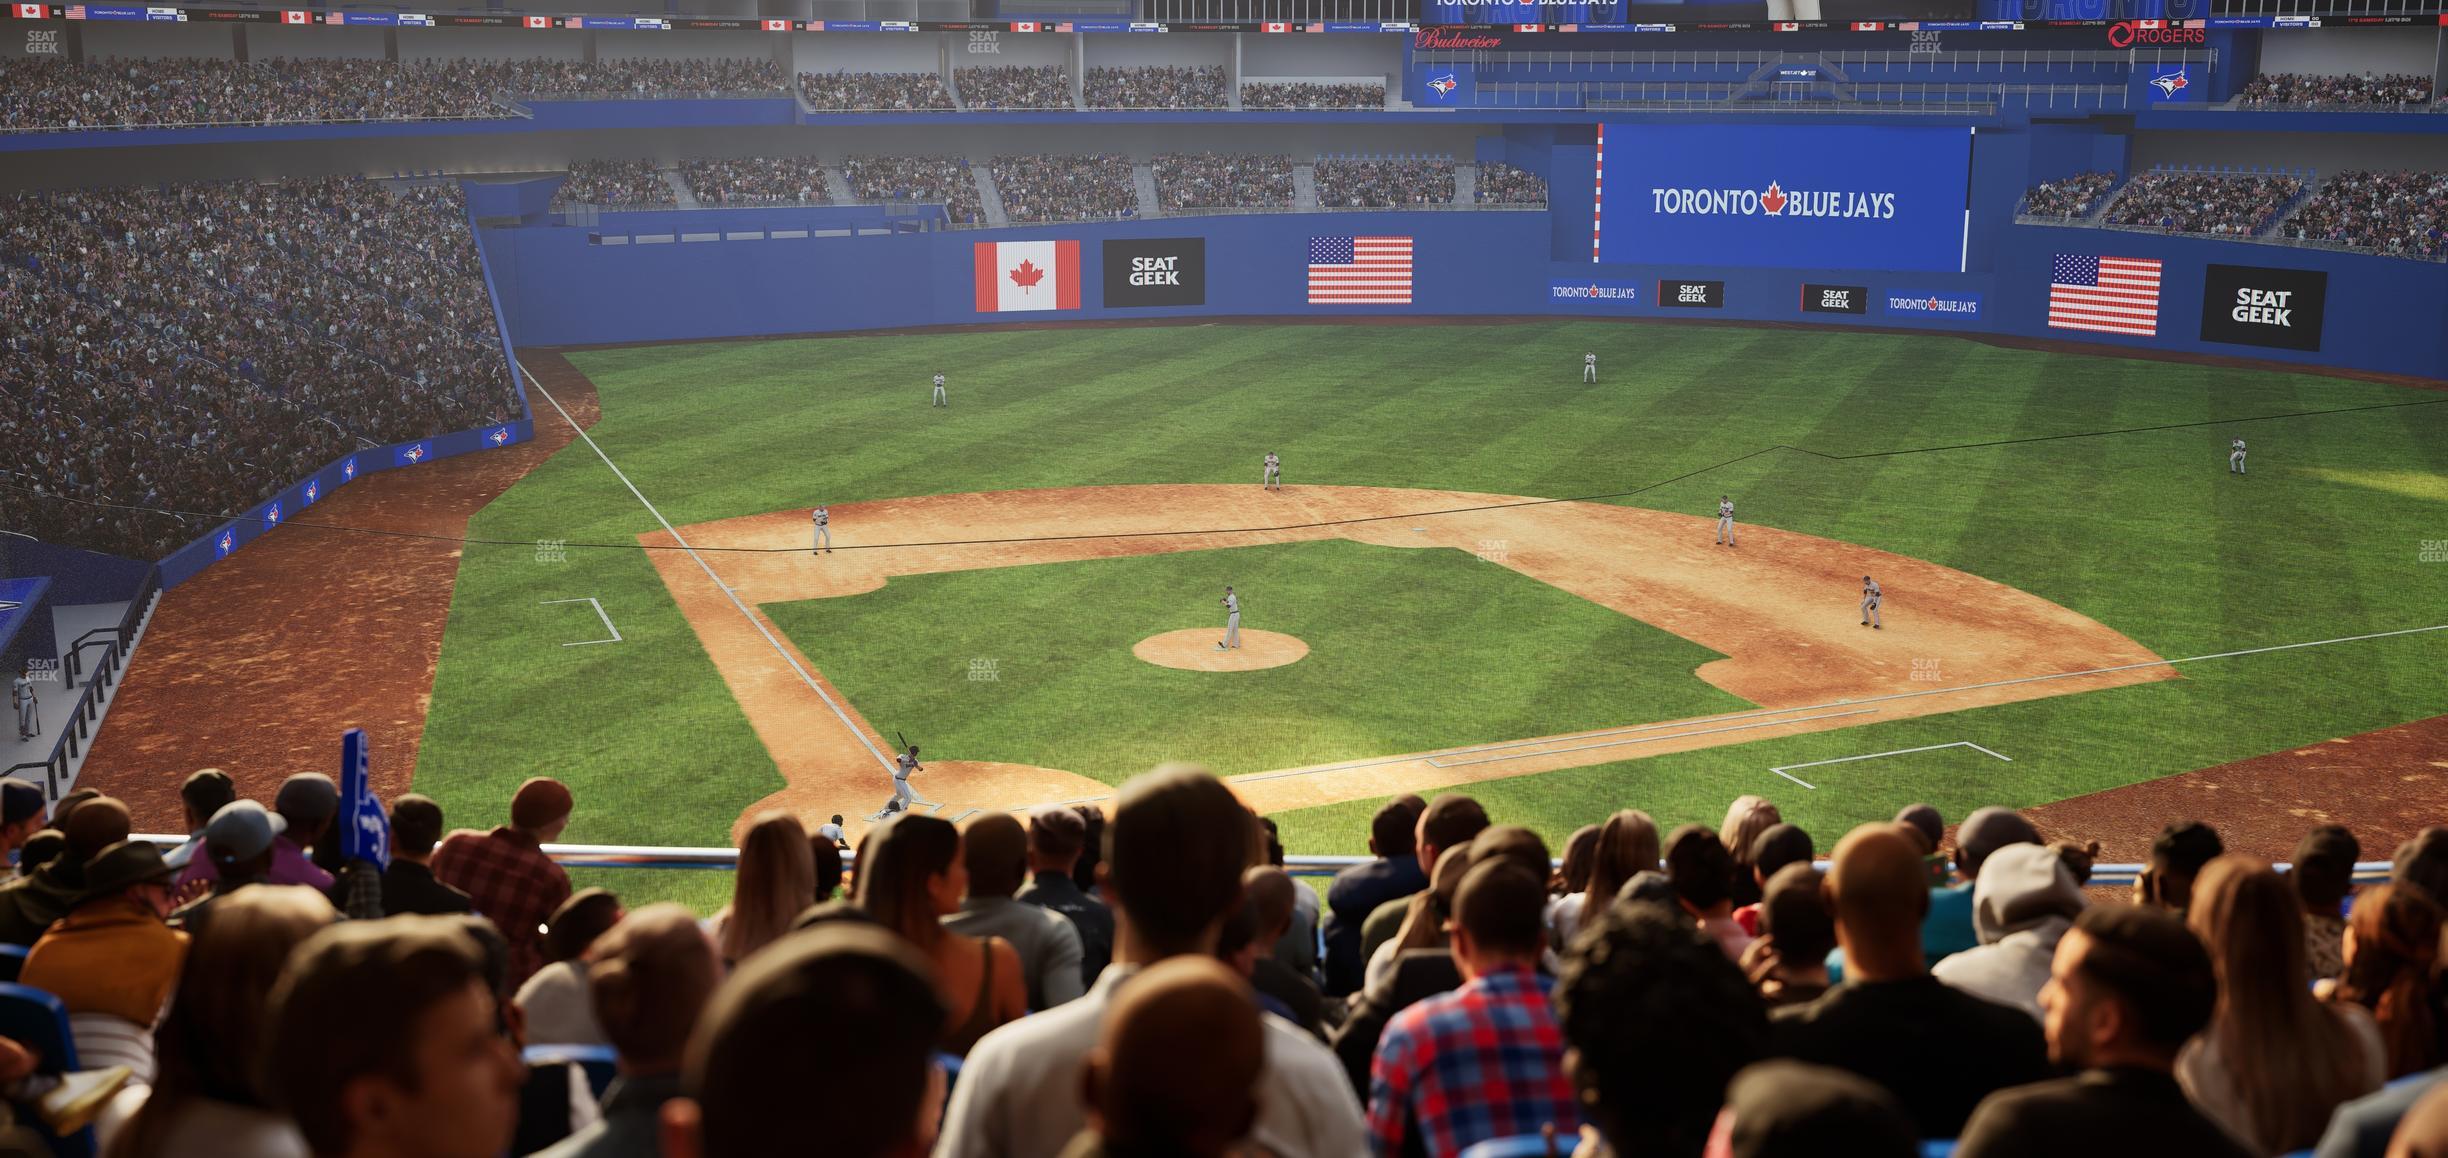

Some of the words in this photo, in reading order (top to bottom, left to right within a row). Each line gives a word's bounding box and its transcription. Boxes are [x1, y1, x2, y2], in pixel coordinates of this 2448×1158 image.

[1414, 26, 1501, 48] Budweiser
[2136, 29, 2205, 43] ROGERS
[1652, 188, 1757, 215] TORONTO
[1789, 191, 1841, 217] BLUE
[1843, 192, 1895, 219] JAYS
[1132, 256, 1178, 271] SEAT
[1129, 271, 1180, 286] GEEK
[1552, 286, 1588, 297] TORONTO
[1599, 287, 1616, 298] BLUE
[1617, 288, 1635, 299] JAYS
[1680, 285, 1706, 294] SEAT
[1823, 290, 1849, 300] SEAT
[1677, 293, 1706, 303] GEEK
[1821, 299, 1850, 308] GEEK
[1890, 298, 1927, 310] TORONTO
[1938, 300, 1958, 312] BLUE
[1958, 301, 1976, 312] JAYS
[2236, 288, 2292, 308] SEAT
[2232, 305, 2292, 327] GEEK
